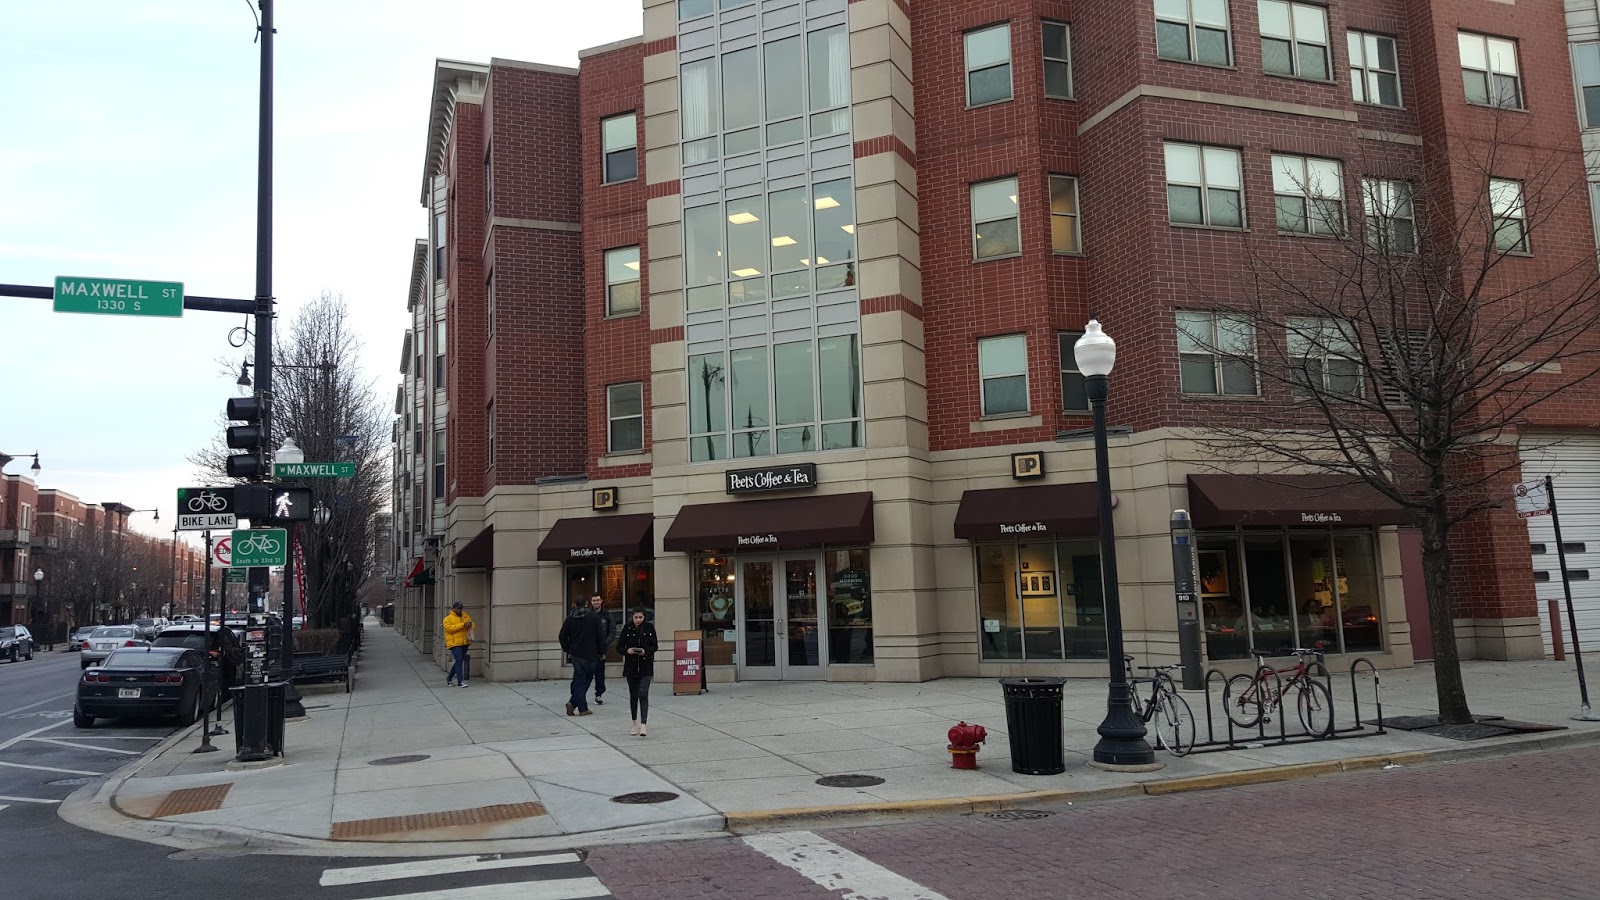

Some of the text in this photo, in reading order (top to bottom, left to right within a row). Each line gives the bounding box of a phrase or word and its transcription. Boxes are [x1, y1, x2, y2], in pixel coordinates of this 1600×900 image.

[61, 281, 177, 299] MAXWELL ST
[97, 299, 141, 311] 1330 S
[287, 464, 338, 475] MAXWELL
[729, 468, 809, 490] Peet's Coffee & Tea
[182, 515, 233, 526] BIKE LANE
[1314, 512, 1329, 522] Coffee
[1331, 512, 1342, 521] Tea
[1014, 523, 1031, 533] Coffee
[1035, 522, 1047, 531] Tea
[750, 535, 764, 545] Coffee
[768, 534, 778, 543] Tea
